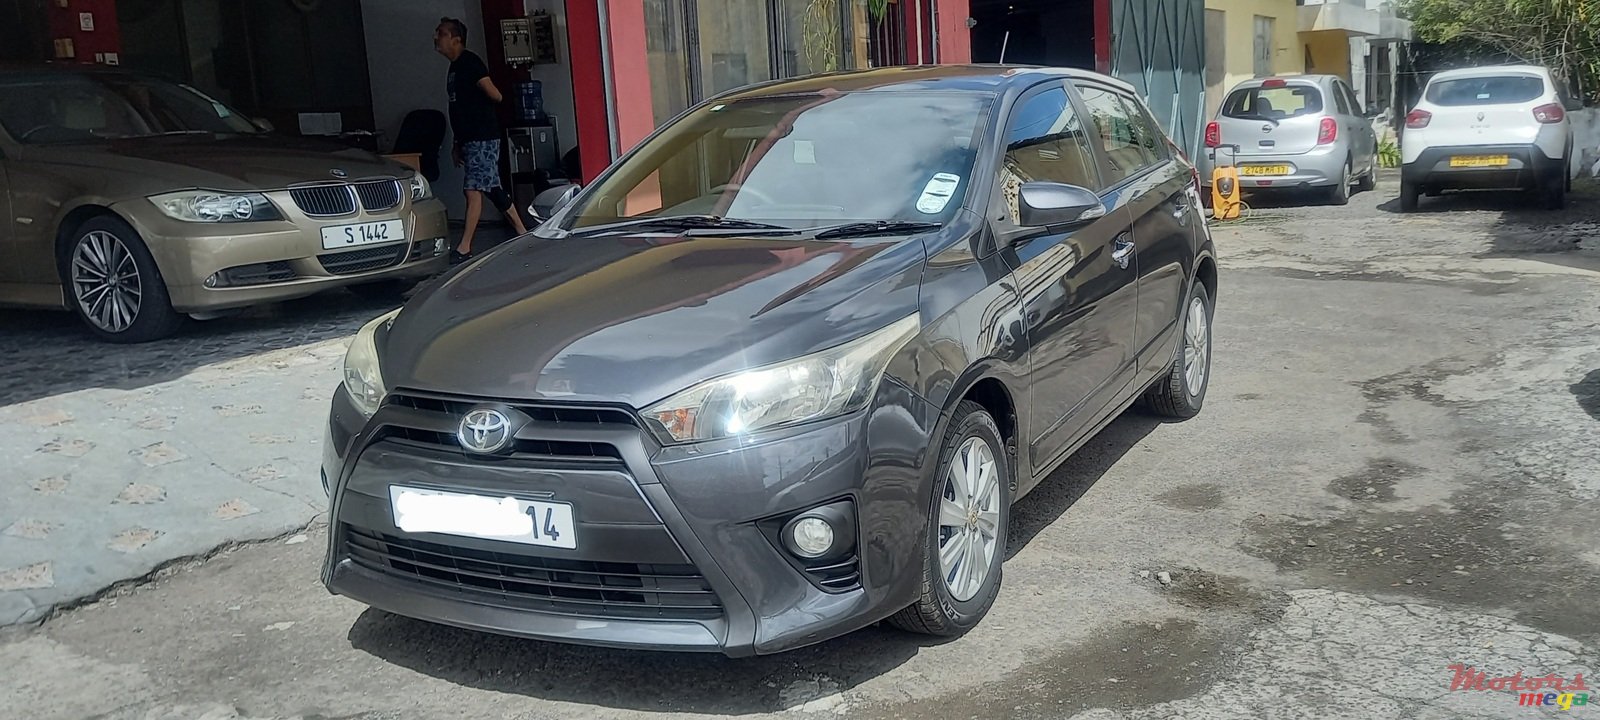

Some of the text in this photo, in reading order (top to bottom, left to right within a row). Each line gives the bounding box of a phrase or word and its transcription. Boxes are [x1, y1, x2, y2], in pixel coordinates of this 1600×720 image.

[344, 223, 388, 243] S 1442
[526, 505, 560, 541] 14
